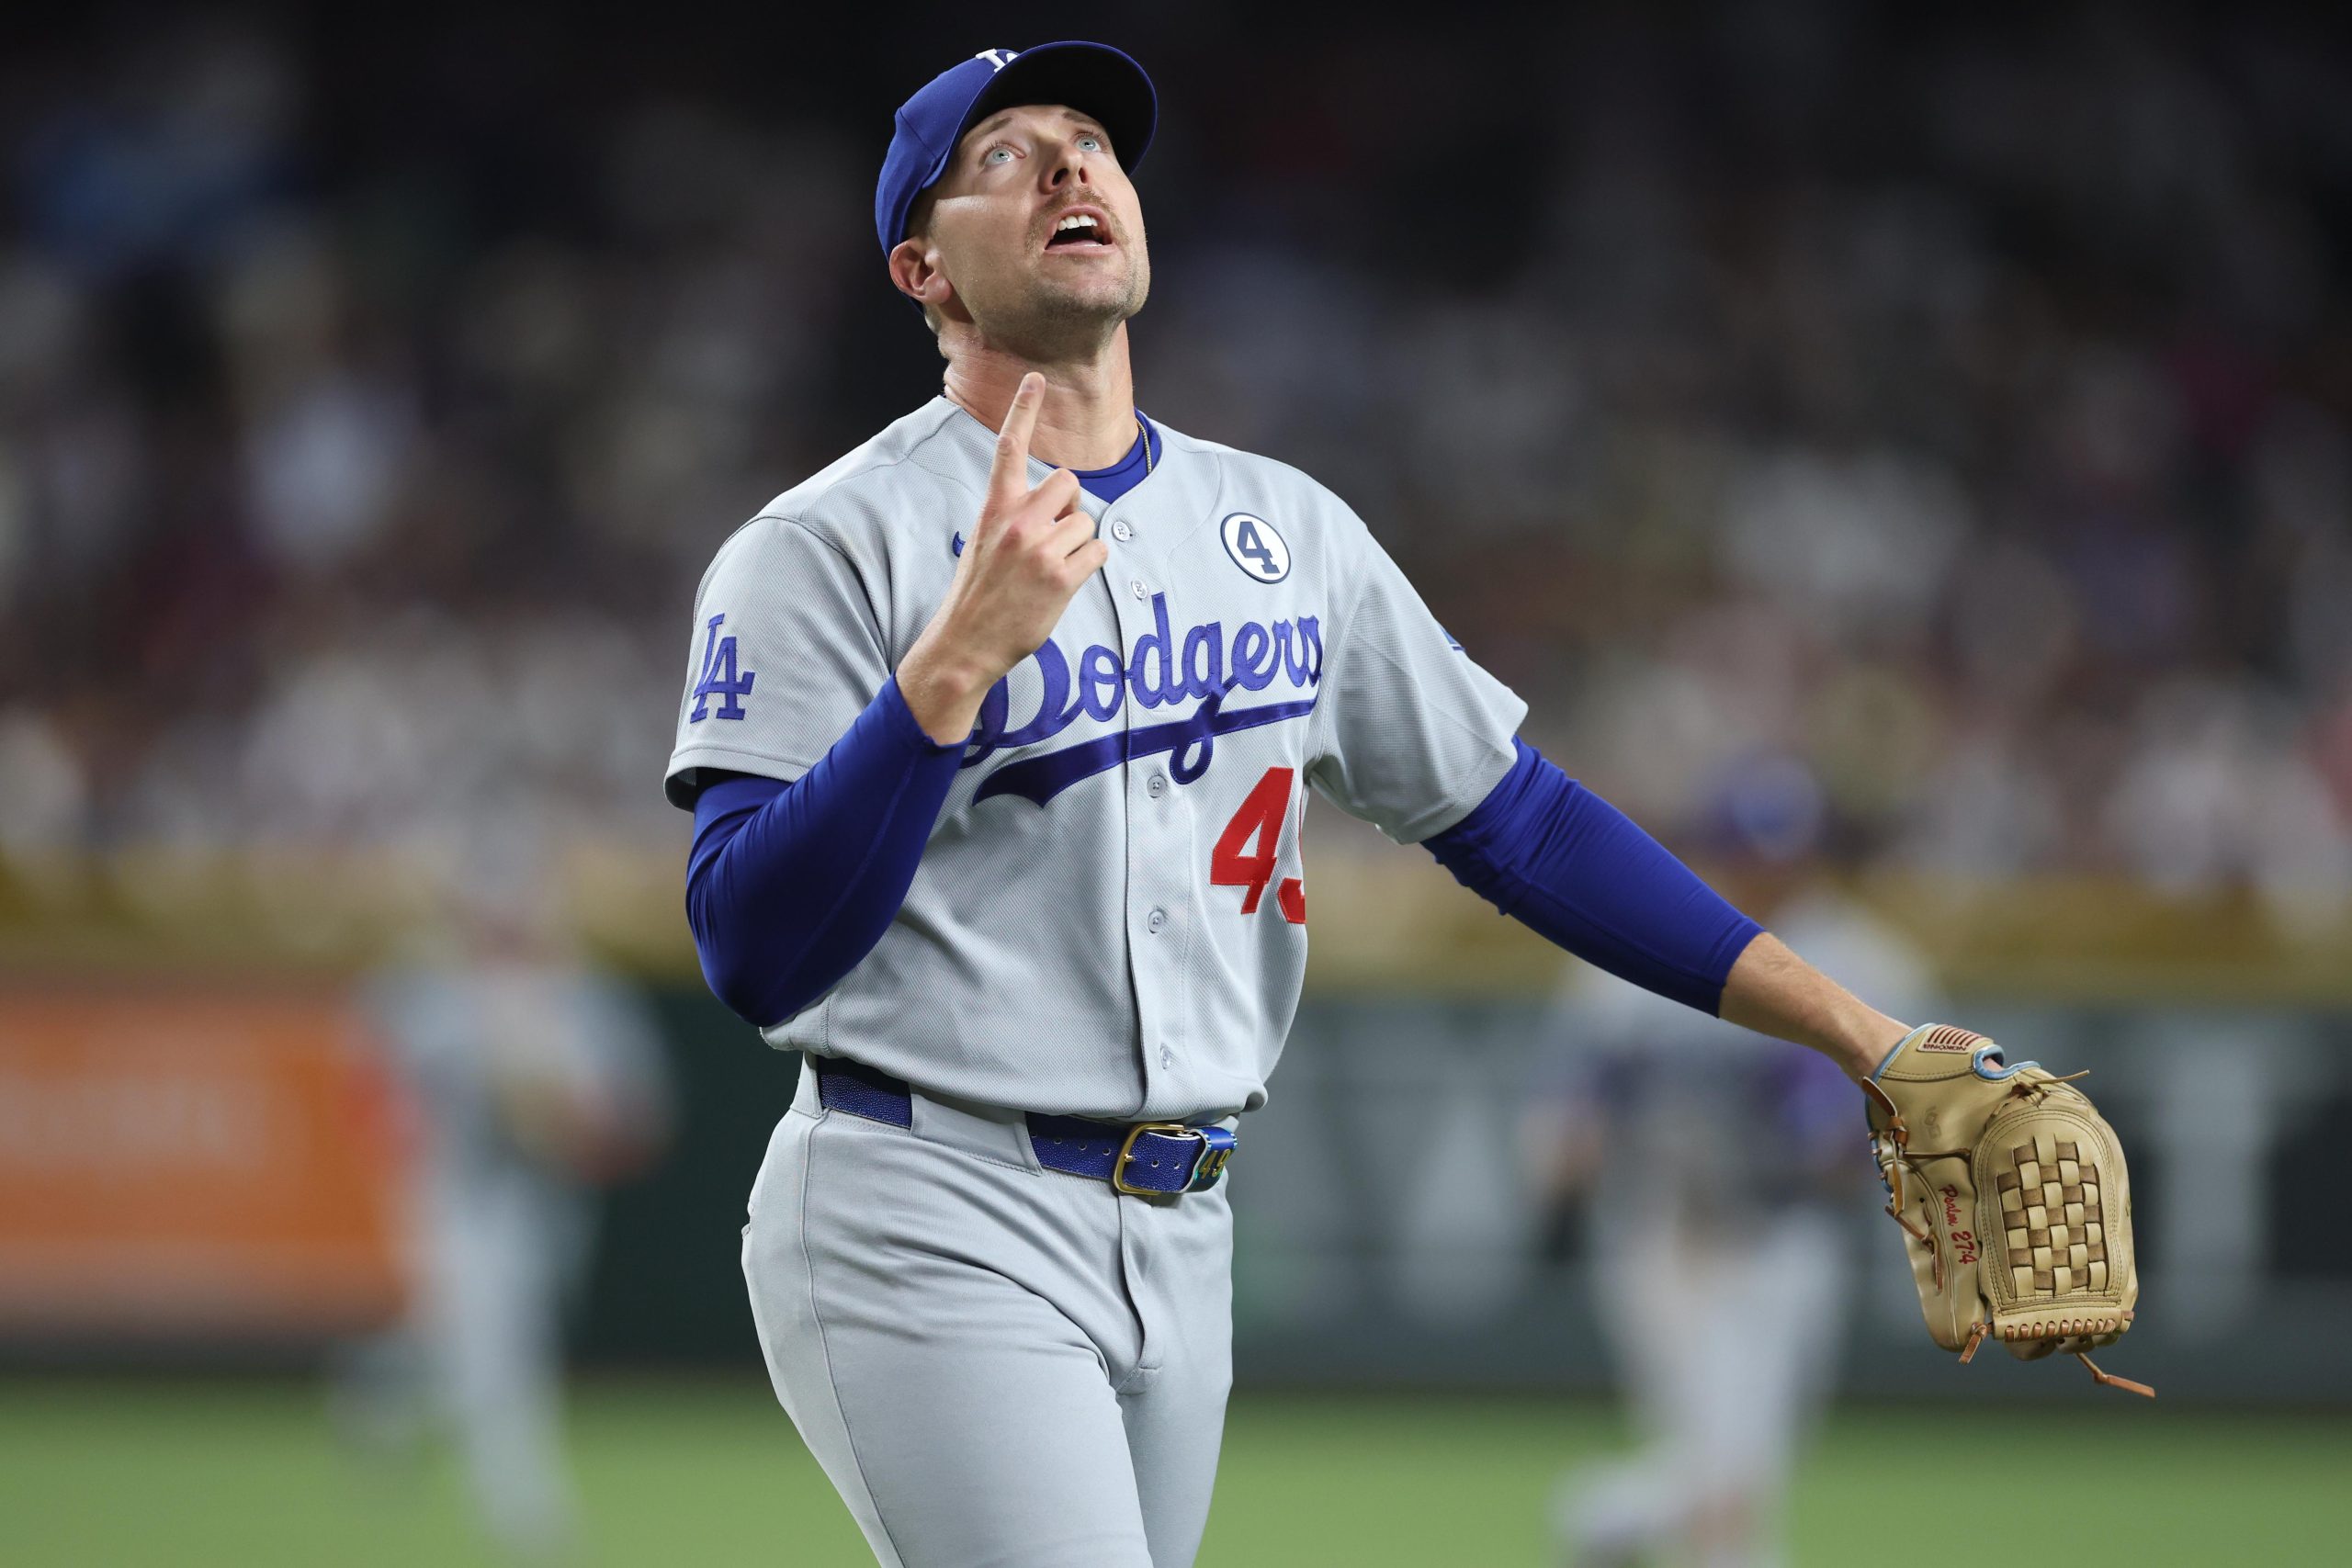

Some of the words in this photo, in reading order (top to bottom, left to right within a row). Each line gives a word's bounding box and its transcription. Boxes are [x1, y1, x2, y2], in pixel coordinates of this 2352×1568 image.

[976, 49, 1019, 73] L
[1237, 521, 1281, 574] 4
[690, 613, 755, 724] LA
[1199, 1149, 1231, 1179] 49
[1939, 1184, 1962, 1226] Psalm
[1951, 1231, 1977, 1264] 27:4
